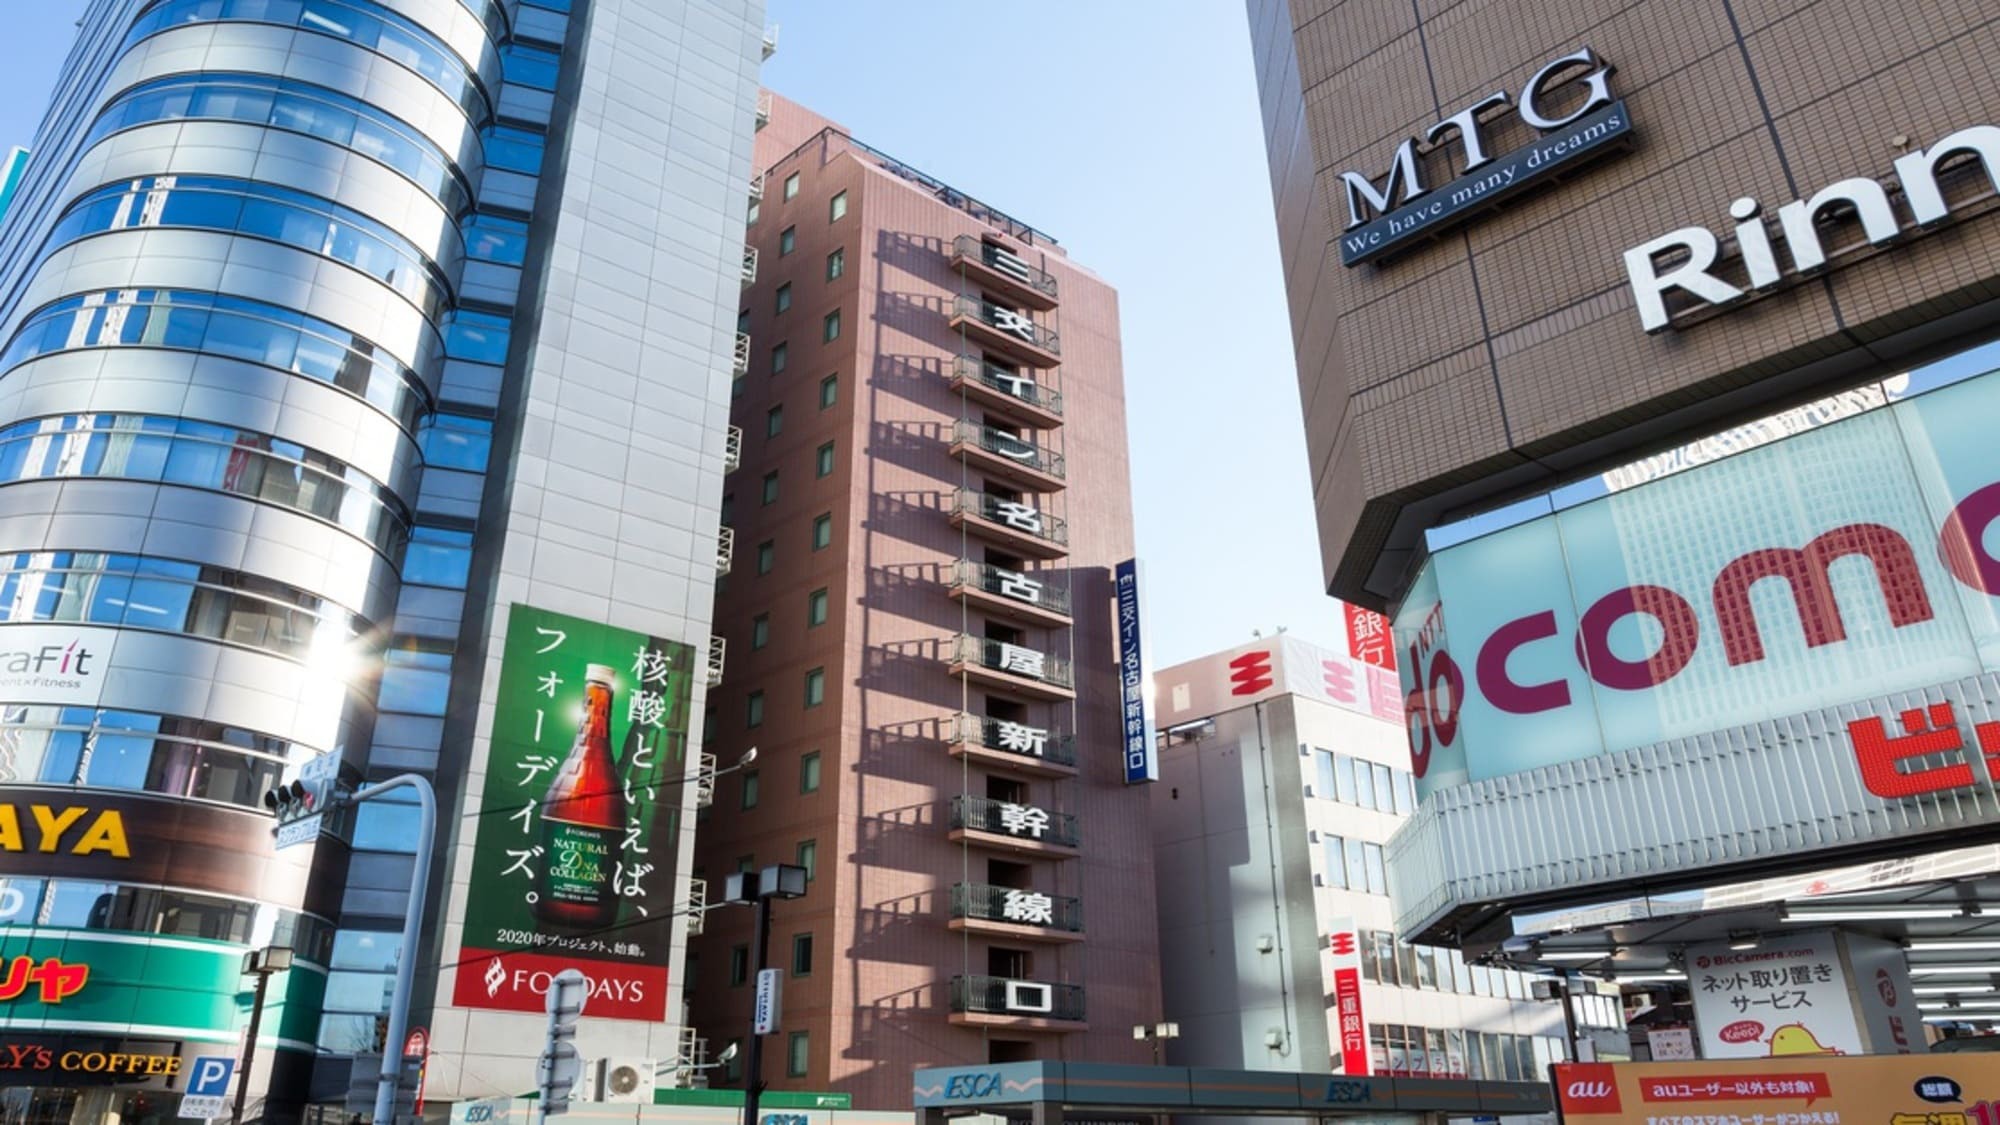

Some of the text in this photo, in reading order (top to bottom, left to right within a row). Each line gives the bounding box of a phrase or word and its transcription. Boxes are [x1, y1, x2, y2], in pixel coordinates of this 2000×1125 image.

[1338, 46, 1615, 229] MTG
[1346, 113, 1622, 254] We have many dreams
[1623, 124, 2000, 333] Rinn
[1847, 701, 2000, 799] ビ
[612, 645, 672, 918] 核酸といえば、
[497, 928, 647, 958] 2020年プロジェクト、始動。
[1713, 947, 1815, 967] BicCamera.com
[1702, 962, 1834, 993] ネット取り置き
[1730, 989, 1813, 1014] サービス
[60, 1050, 182, 1076] COFFEE
[197, 1060, 226, 1092] P
[943, 1072, 1002, 1100] ESCA
[1567, 1080, 1613, 1098] au
[1653, 1079, 1816, 1098] auユーザー以外も対象!
